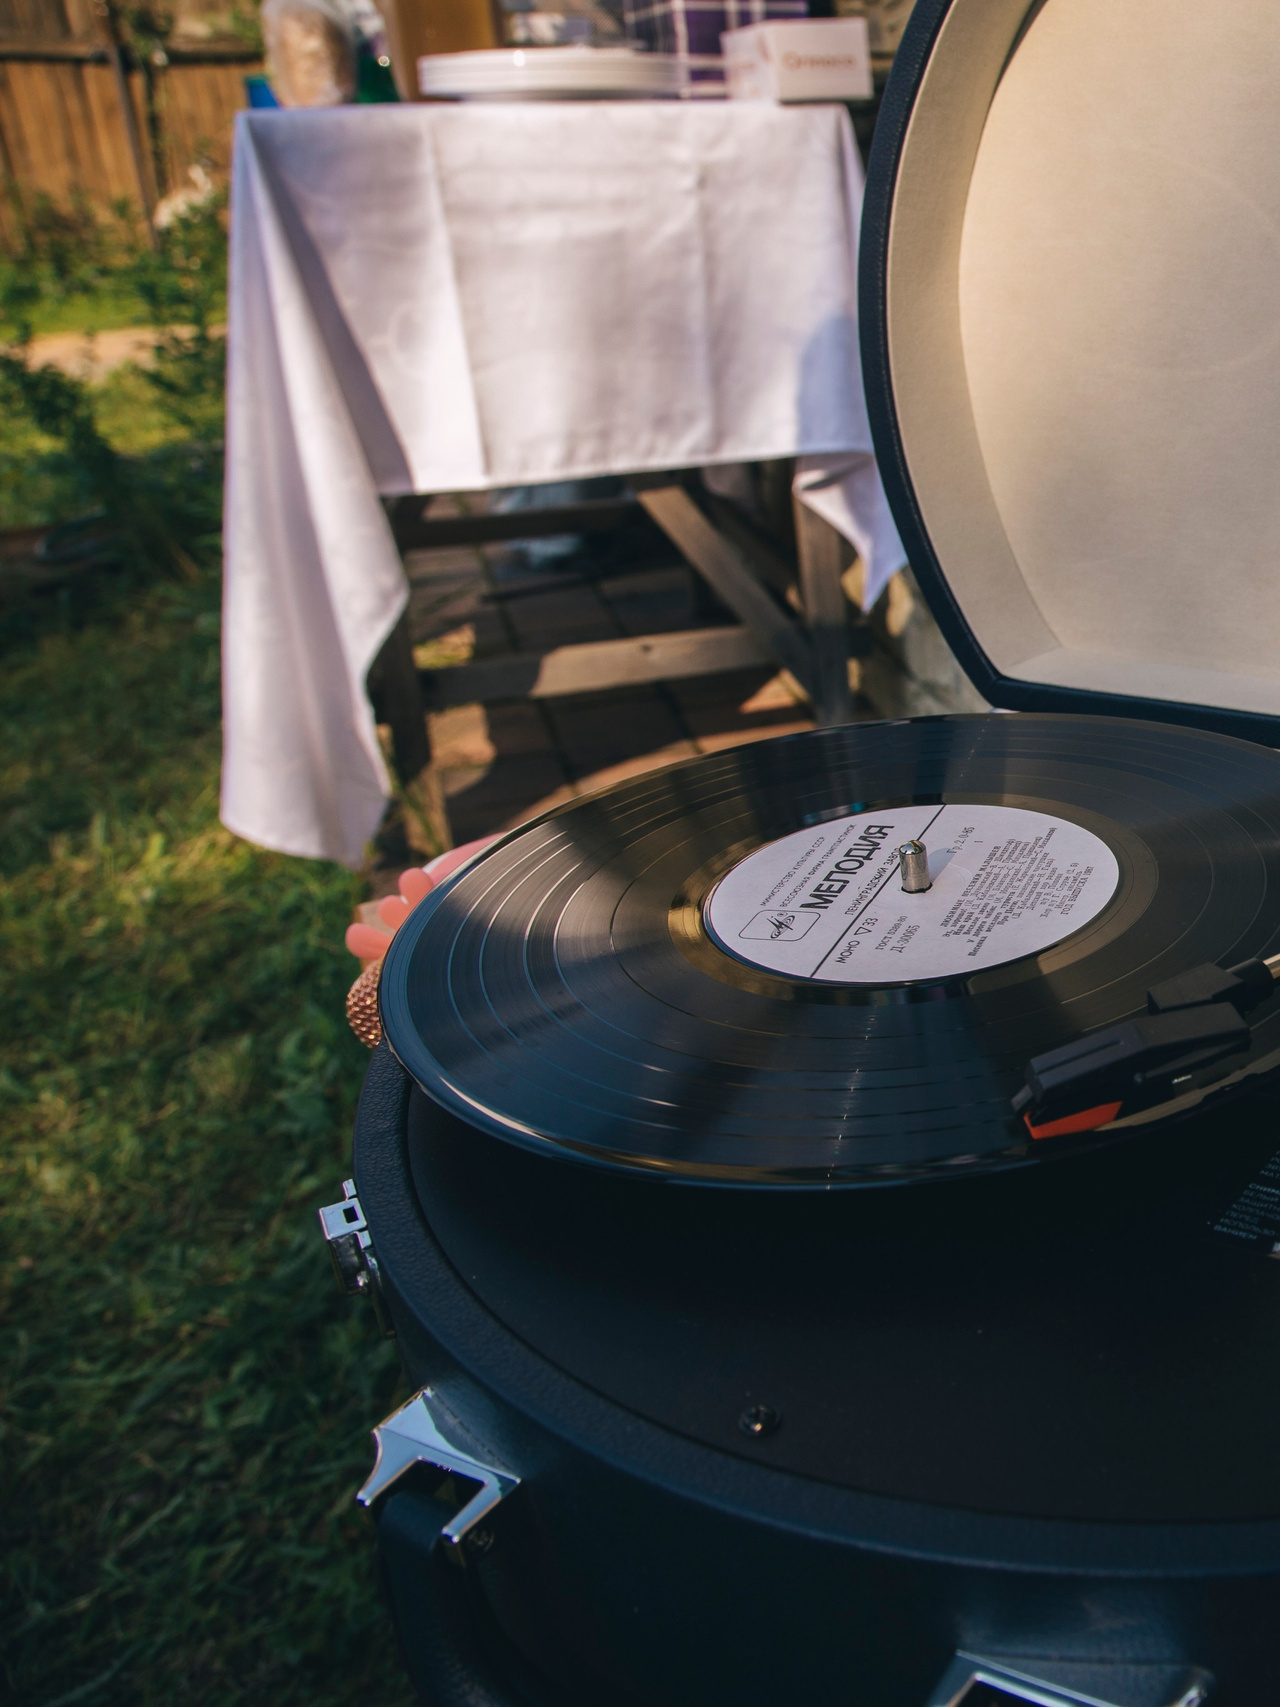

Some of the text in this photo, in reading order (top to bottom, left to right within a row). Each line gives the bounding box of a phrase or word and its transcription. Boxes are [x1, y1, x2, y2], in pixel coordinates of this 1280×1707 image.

[758, 837, 827, 906] МИНИСТЕРСТВО КУЛЬТУРЫ СССР
[778, 876, 812, 907] ВСЕСОЮЗНАЯ
[806, 860, 827, 875] ФИРМА
[798, 825, 894, 909] МЕЛОДИЯ
[842, 868, 890, 915] ЛЕНИНГРАДСКИЙ
[939, 899, 965, 927] ЛЮБИМЫЕ
[1059, 904, 1074, 915] ГОД
[832, 918, 880, 963] МОНО 33
[874, 916, 909, 950] ГОСТ 5289-80
[887, 925, 922, 953] Д-30065
